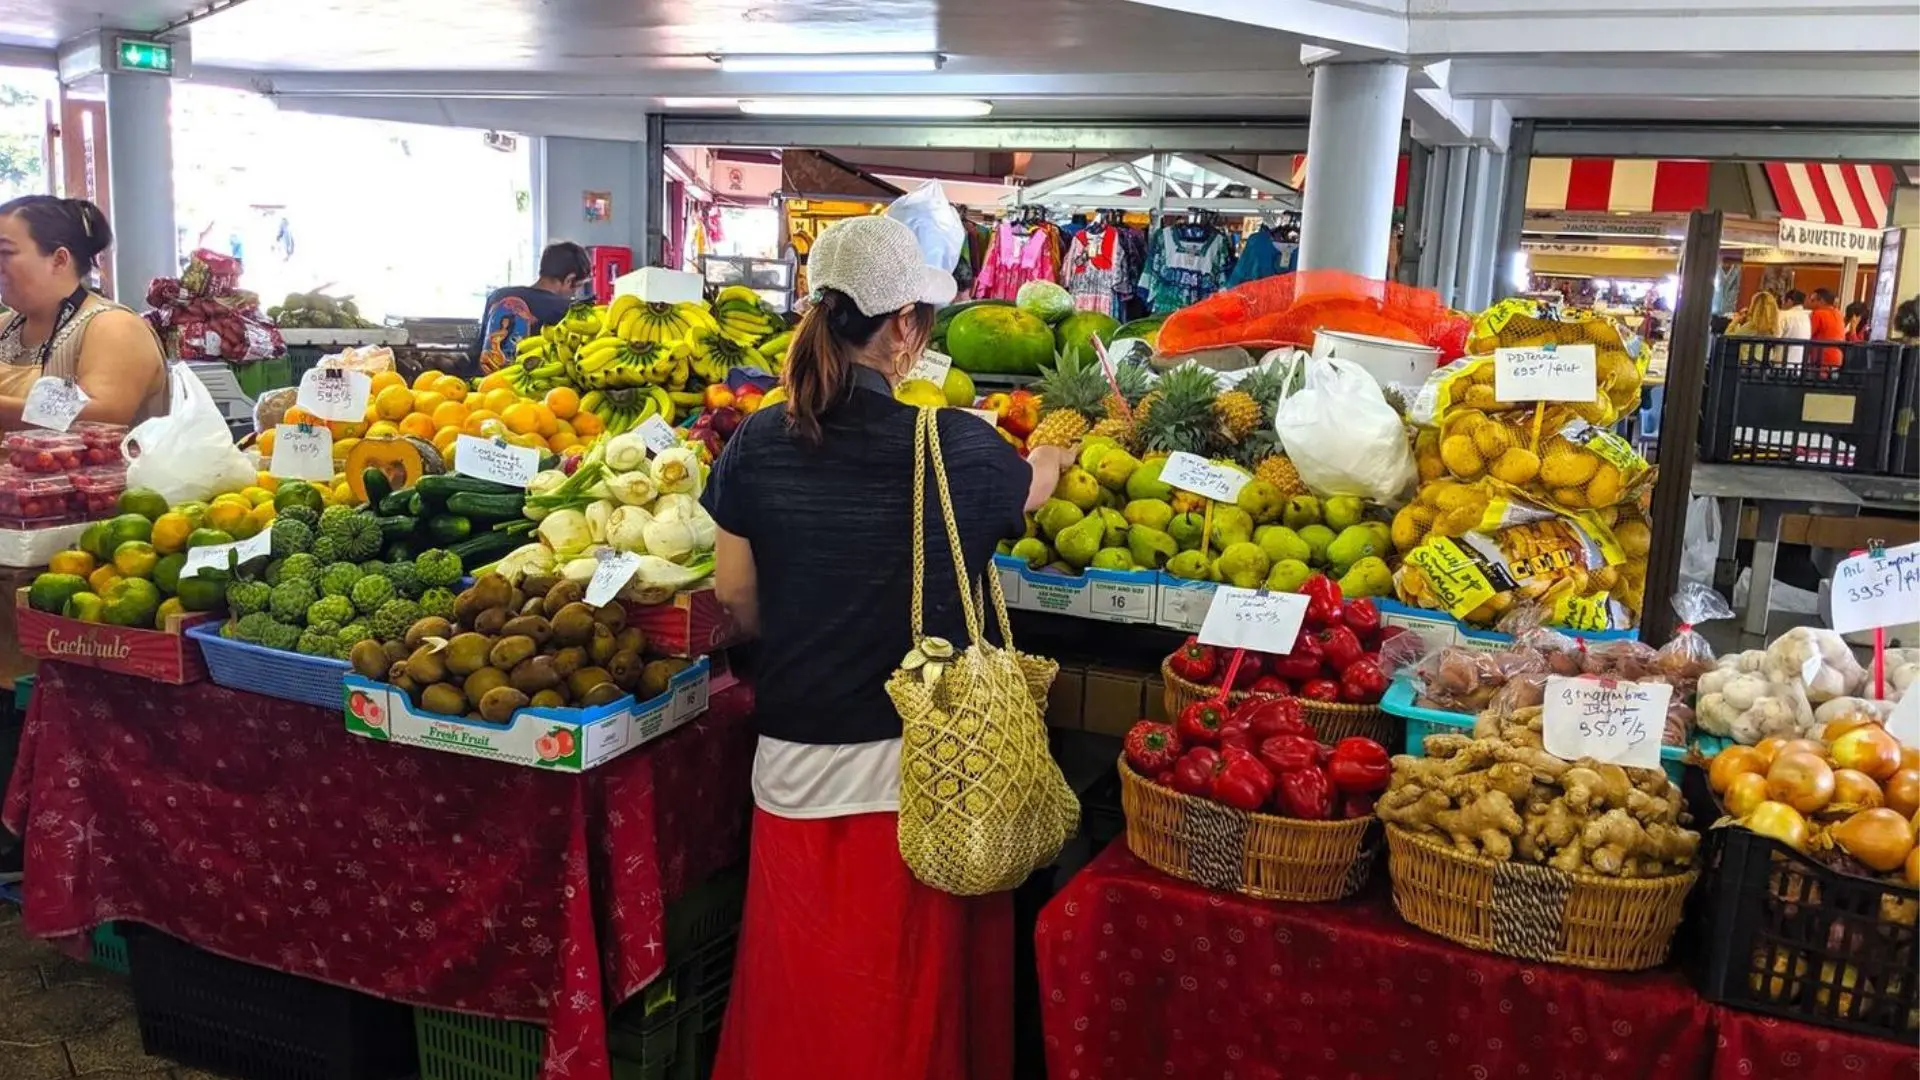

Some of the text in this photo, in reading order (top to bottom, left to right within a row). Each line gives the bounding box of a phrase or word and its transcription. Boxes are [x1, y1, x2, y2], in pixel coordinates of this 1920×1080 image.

[1780, 222, 1796, 243] LA
[1799, 226, 1846, 248] BUVETTE
[1848, 233, 1866, 249] DU
[1111, 594, 1126, 609] 16
[46, 628, 132, 659] Cachirulo
[428, 726, 491, 746] Fresh Fruit
